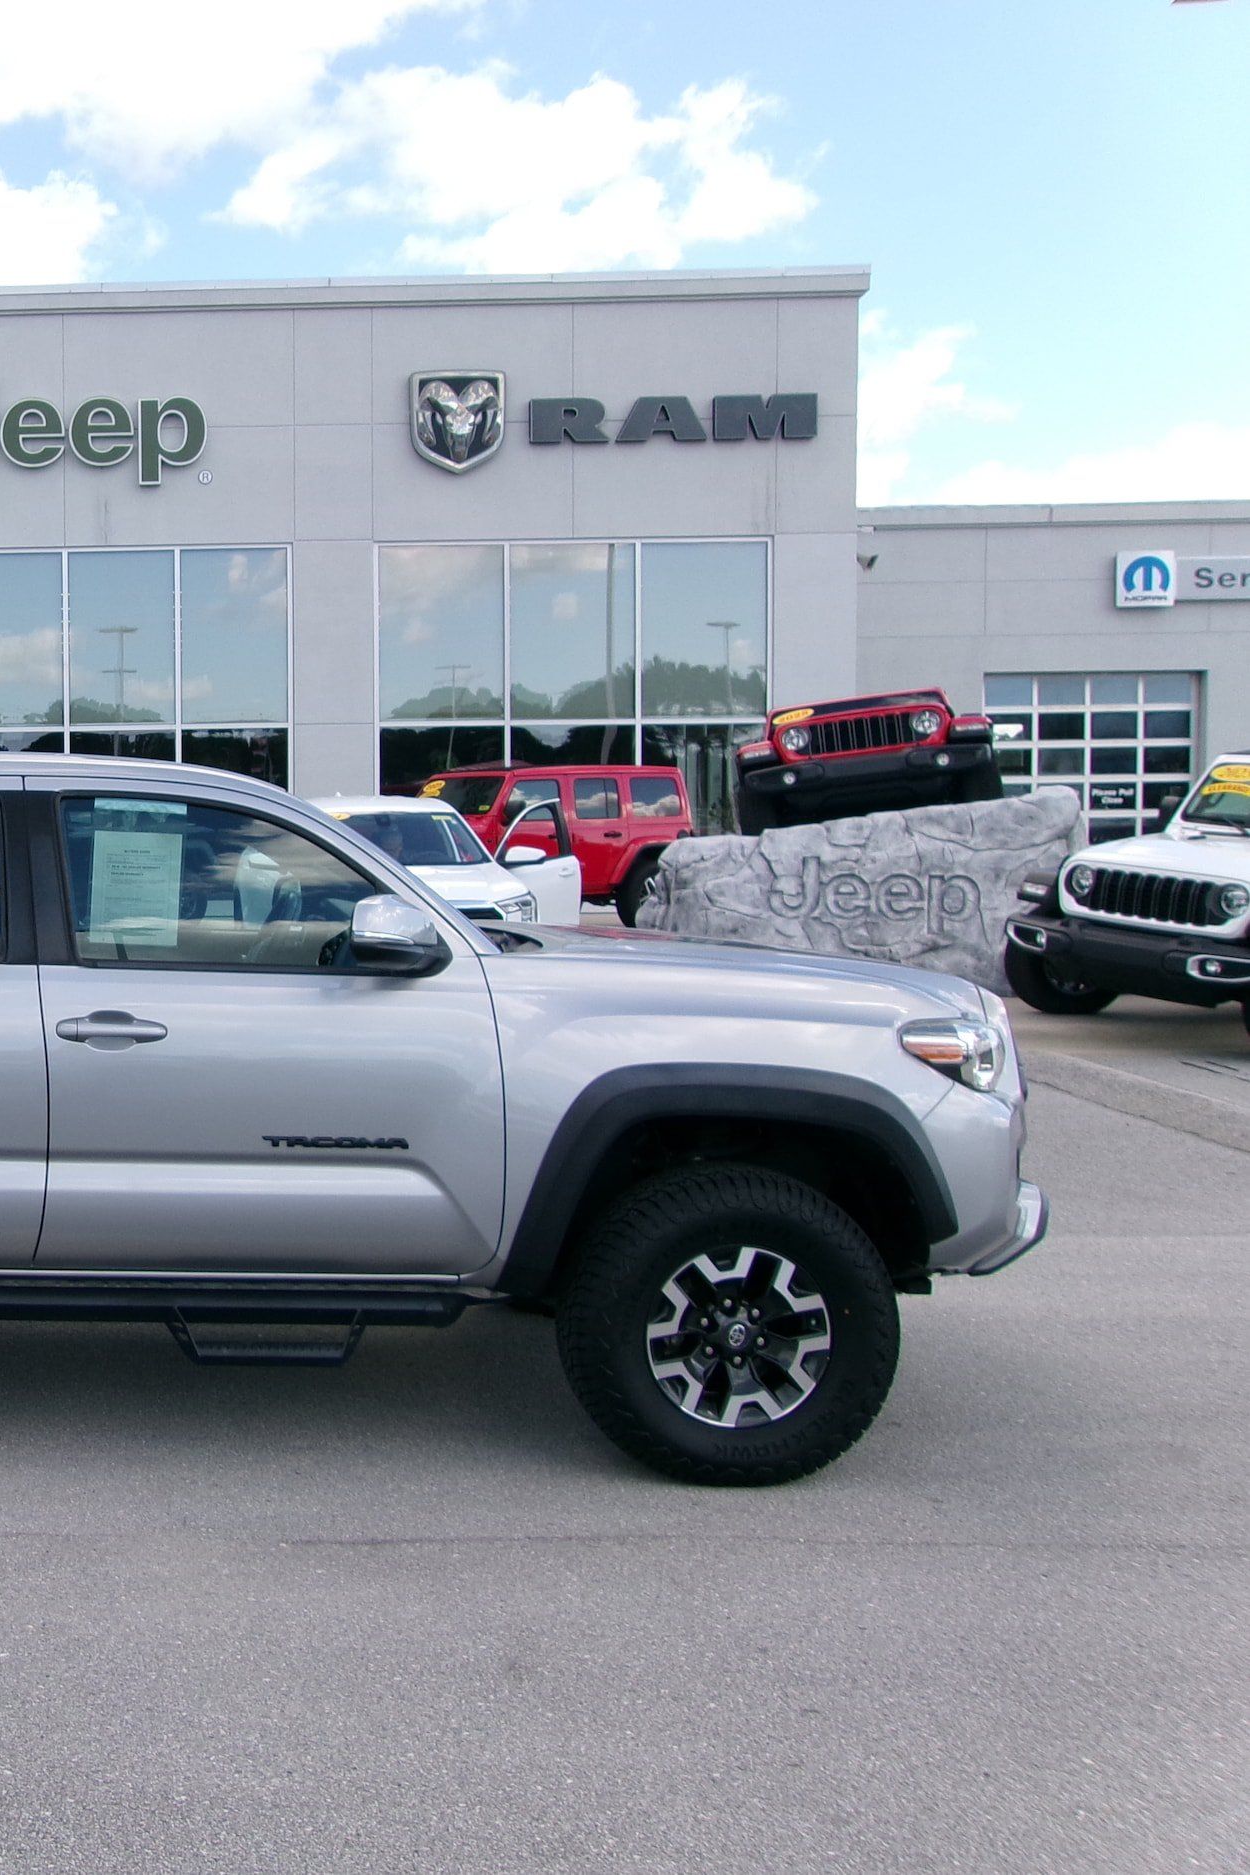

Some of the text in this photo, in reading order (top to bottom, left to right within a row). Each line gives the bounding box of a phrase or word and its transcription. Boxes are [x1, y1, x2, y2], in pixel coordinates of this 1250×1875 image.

[529, 393, 818, 443] RAM
[769, 856, 980, 935] Jeep
[262, 1136, 409, 1149] TACOMA
